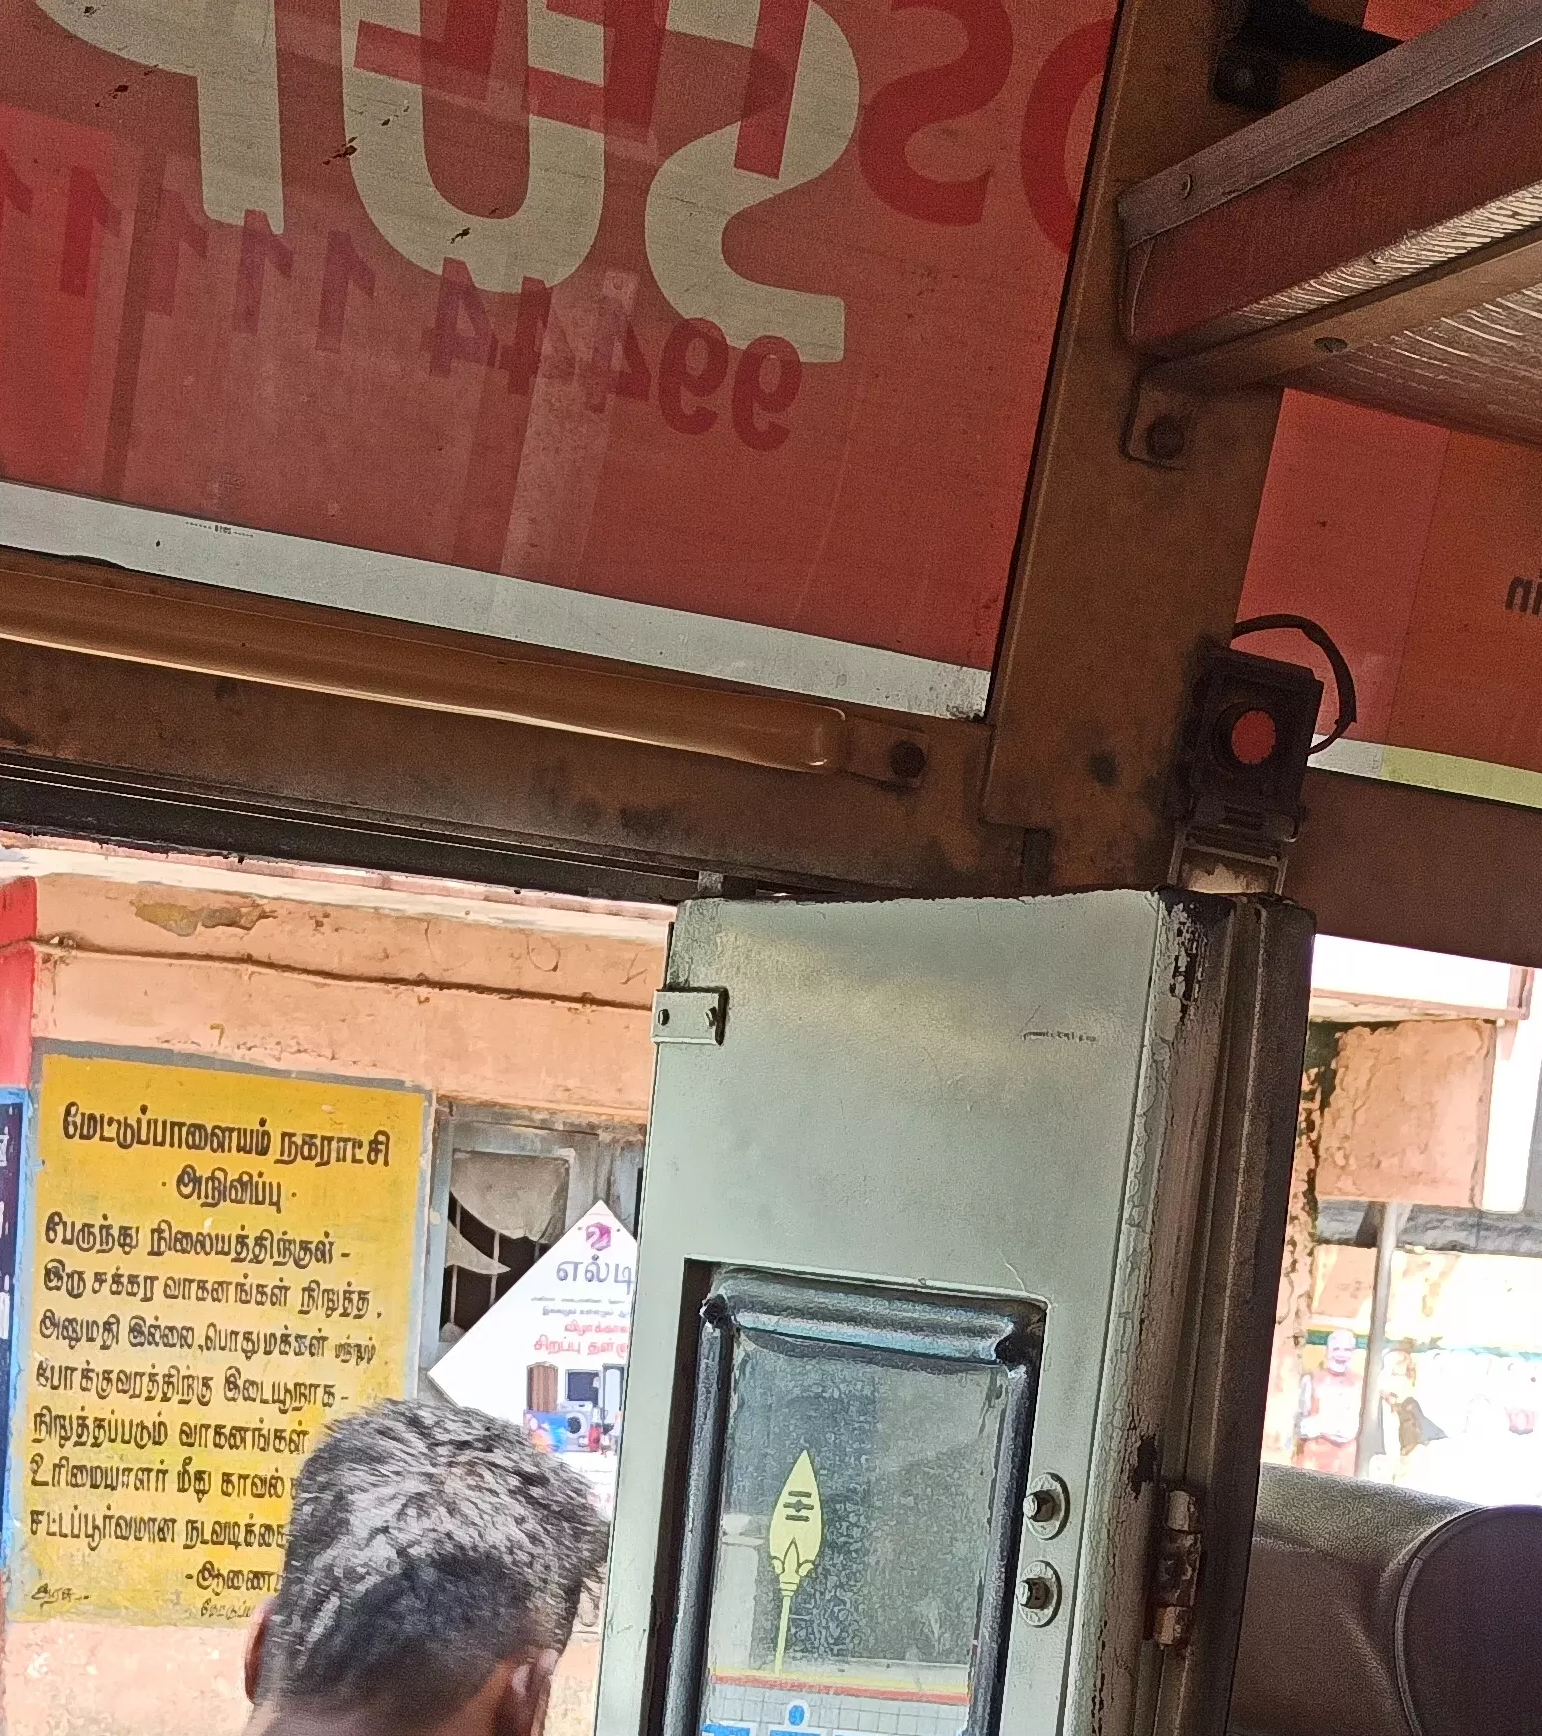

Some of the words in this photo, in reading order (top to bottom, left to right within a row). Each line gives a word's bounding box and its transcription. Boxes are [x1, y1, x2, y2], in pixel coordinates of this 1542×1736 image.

[62, 1101, 272, 1157] மேட்டுப்பாளையம்
[274, 1128, 391, 1168] நகராட்சி
[176, 1164, 282, 1213] அறிவிப்பு
[44, 1258, 86, 1299] இரு
[91, 1265, 159, 1303] சக்கர
[163, 1272, 291, 1307] வாகனங்கள்
